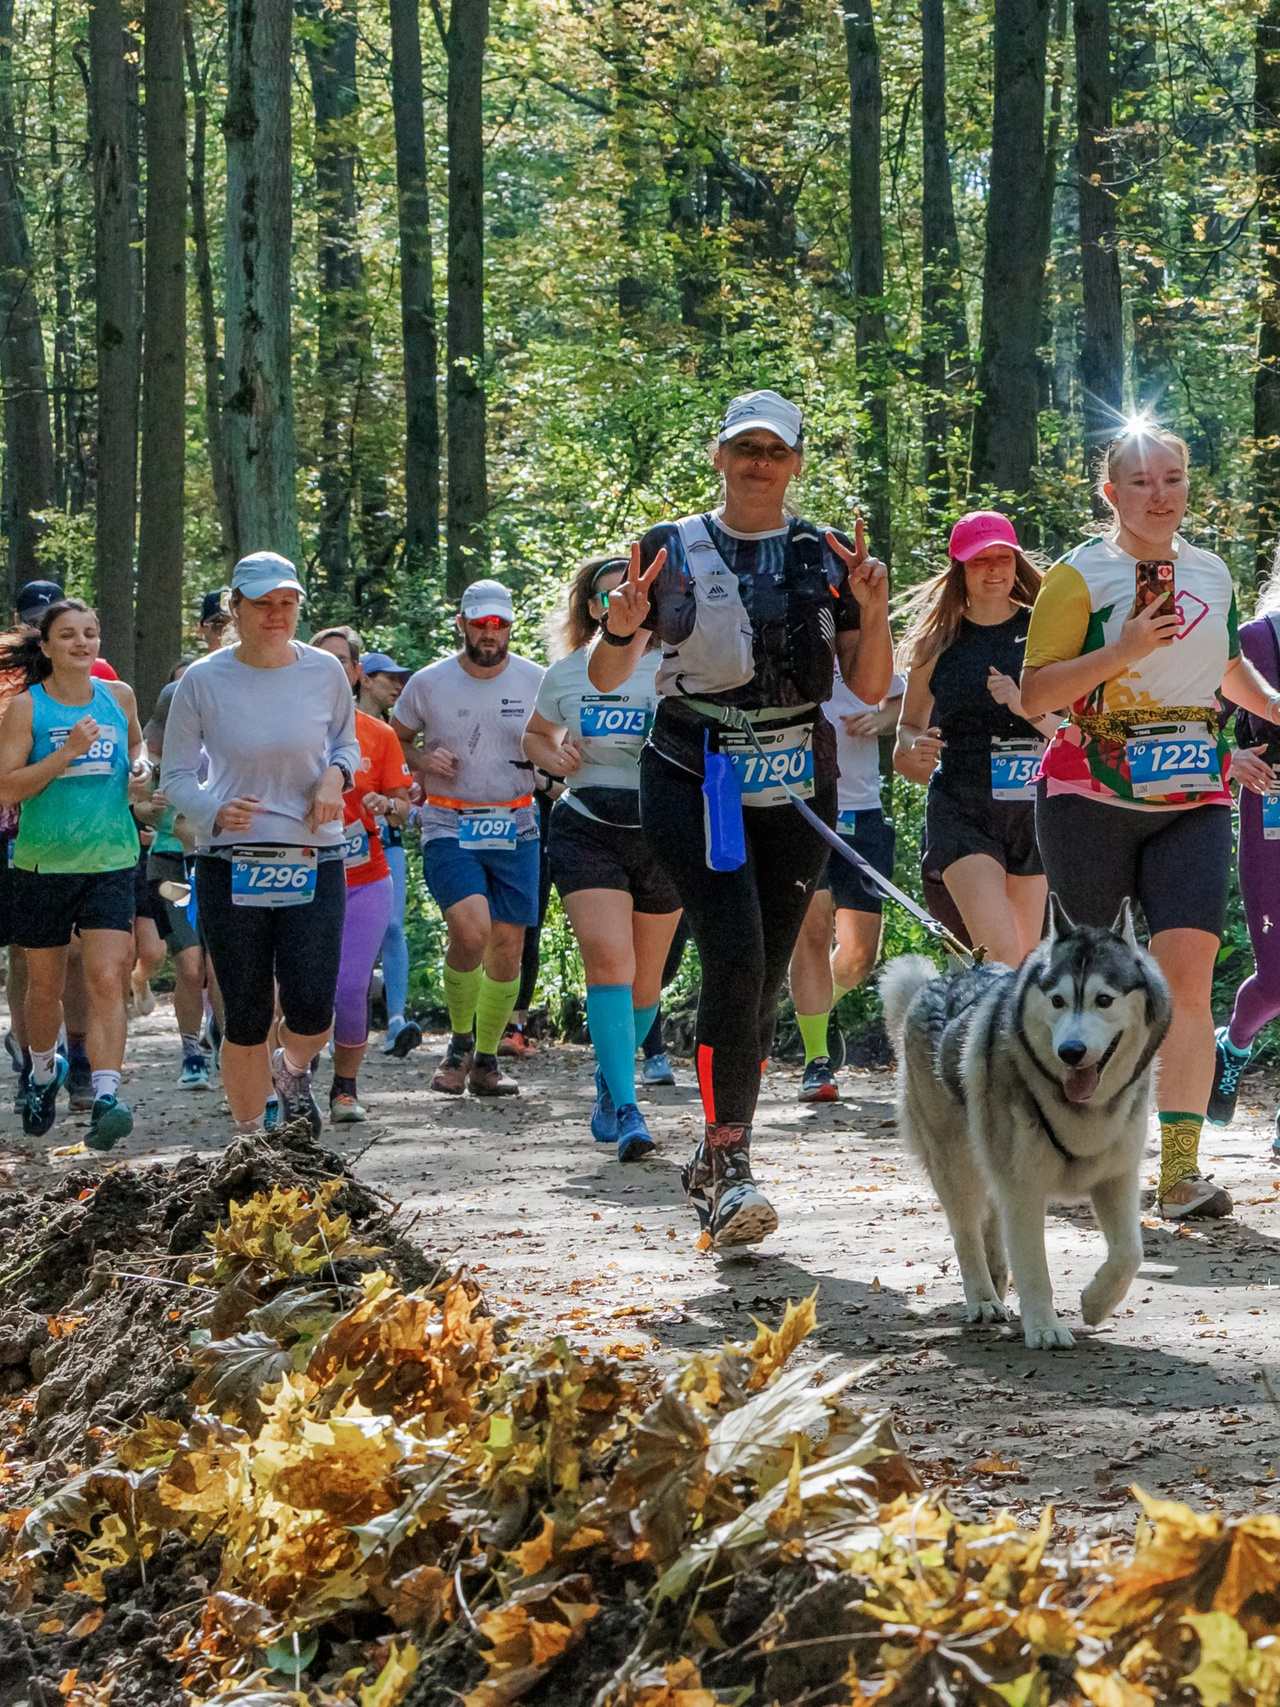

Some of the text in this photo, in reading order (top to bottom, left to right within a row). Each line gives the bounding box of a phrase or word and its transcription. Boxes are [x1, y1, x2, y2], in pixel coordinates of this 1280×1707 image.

[596, 710, 645, 731] 1013
[744, 750, 805, 783] 1190
[1133, 744, 1210, 772] 10 1225
[1267, 797, 1278, 805] 10
[472, 820, 511, 836] 1091
[248, 867, 311, 887] 1296
